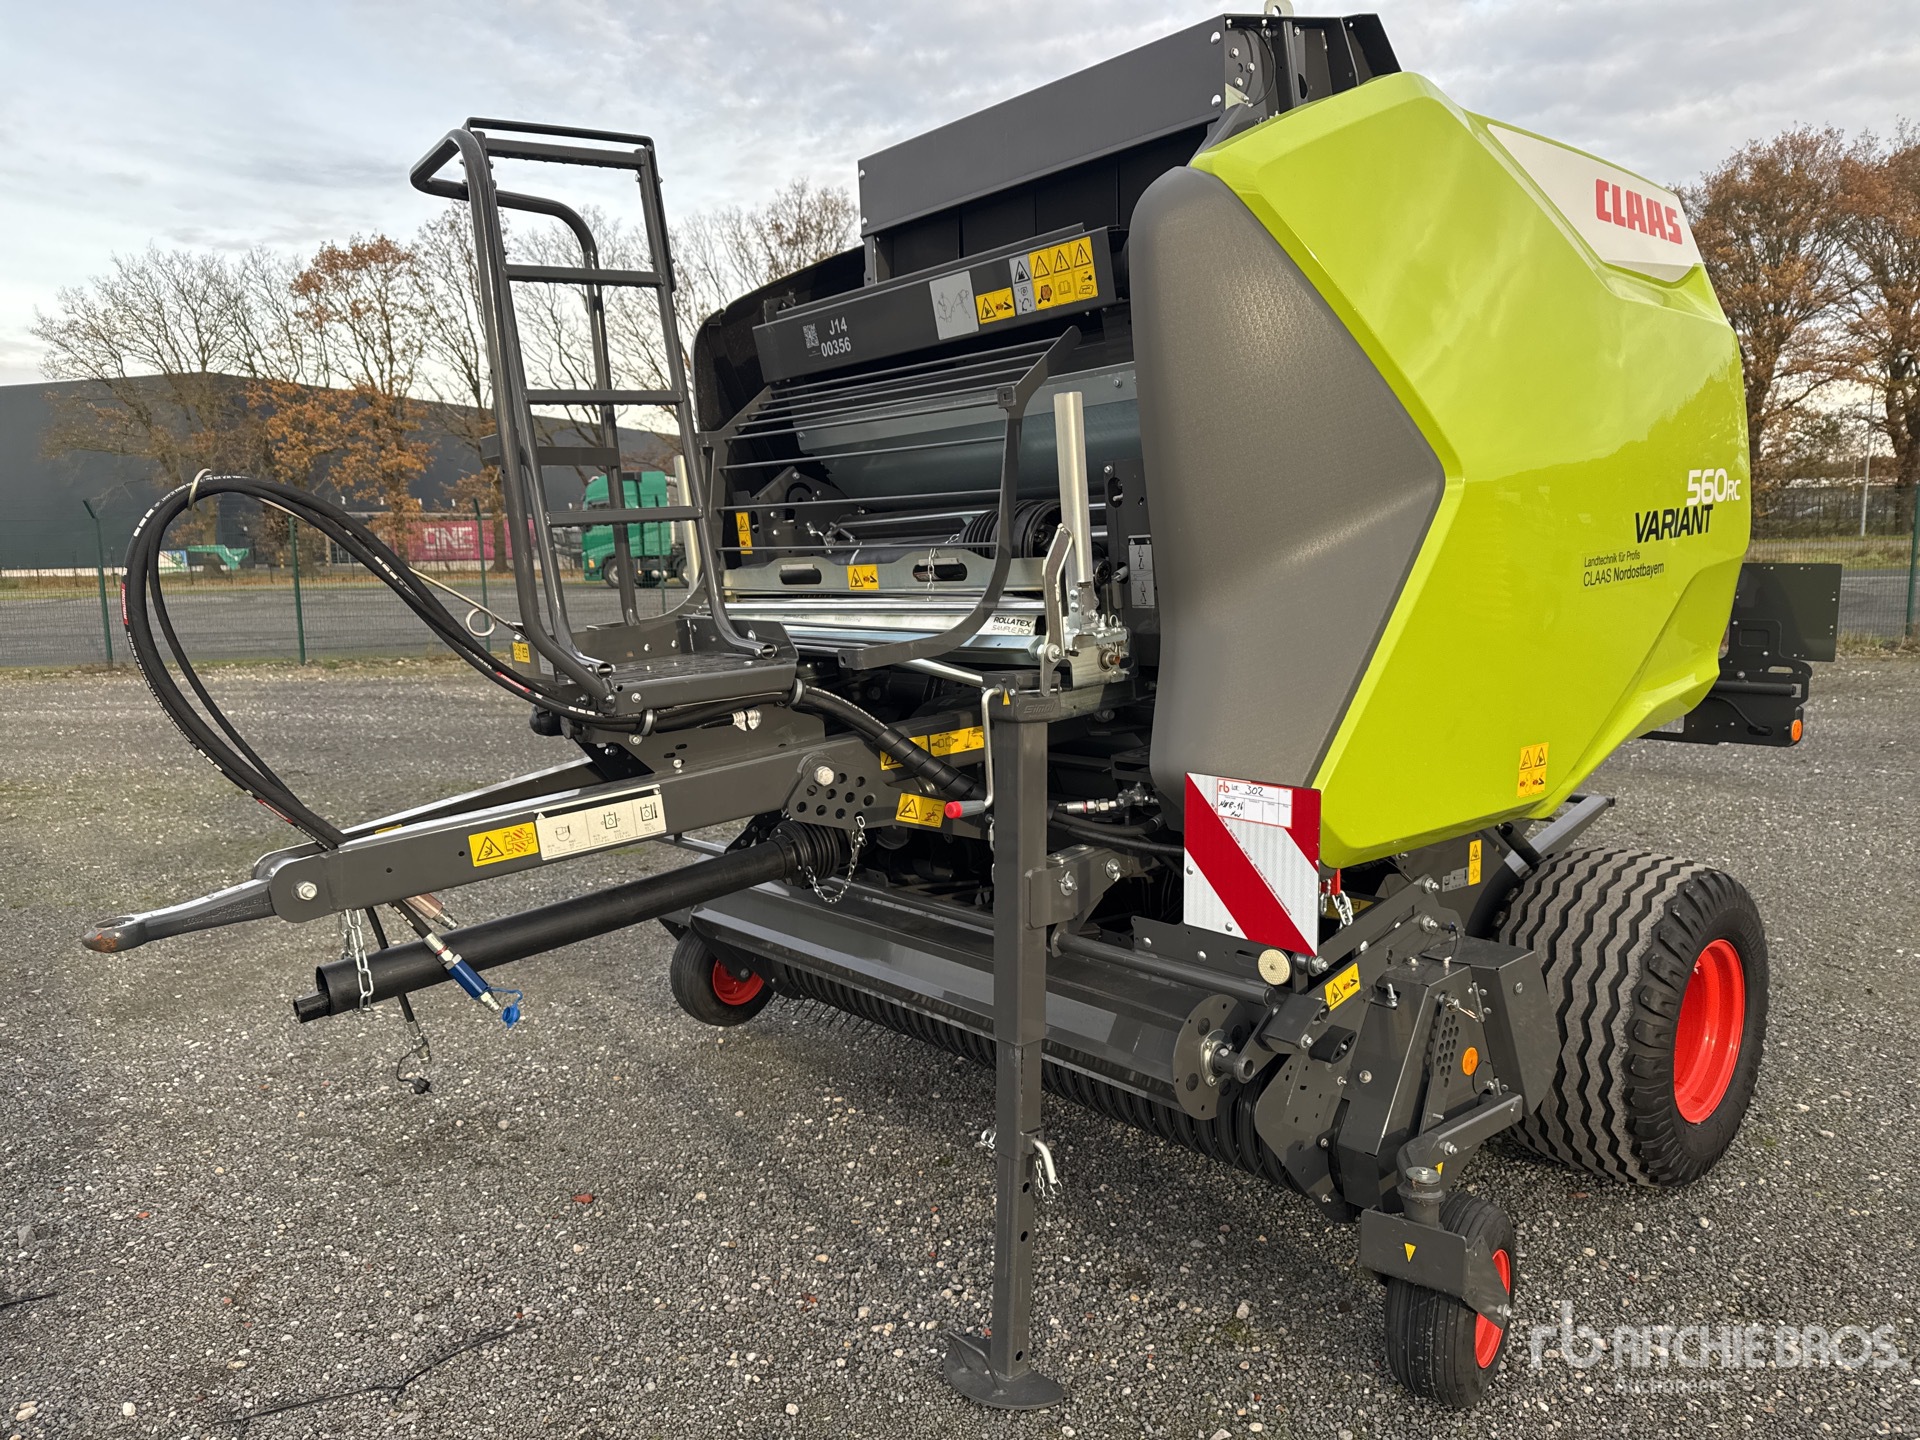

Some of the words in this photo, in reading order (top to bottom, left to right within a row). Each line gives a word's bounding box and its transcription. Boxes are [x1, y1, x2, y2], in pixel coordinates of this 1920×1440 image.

[1596, 178, 1682, 245] CLAAS
[829, 316, 848, 335] J14
[820, 336, 851, 357] 00356
[1635, 504, 1713, 543] VARIANT
[423, 526, 473, 550] ONE
[1584, 554, 1617, 568] Landtechnik
[1618, 554, 1626, 563] für
[1626, 550, 1640, 561] Profis
[1583, 569, 1612, 587] CLAAS
[1613, 562, 1664, 582] Nordostbayern
[993, 616, 1032, 627] ROLLATEX
[1244, 784, 1264, 797] 302
